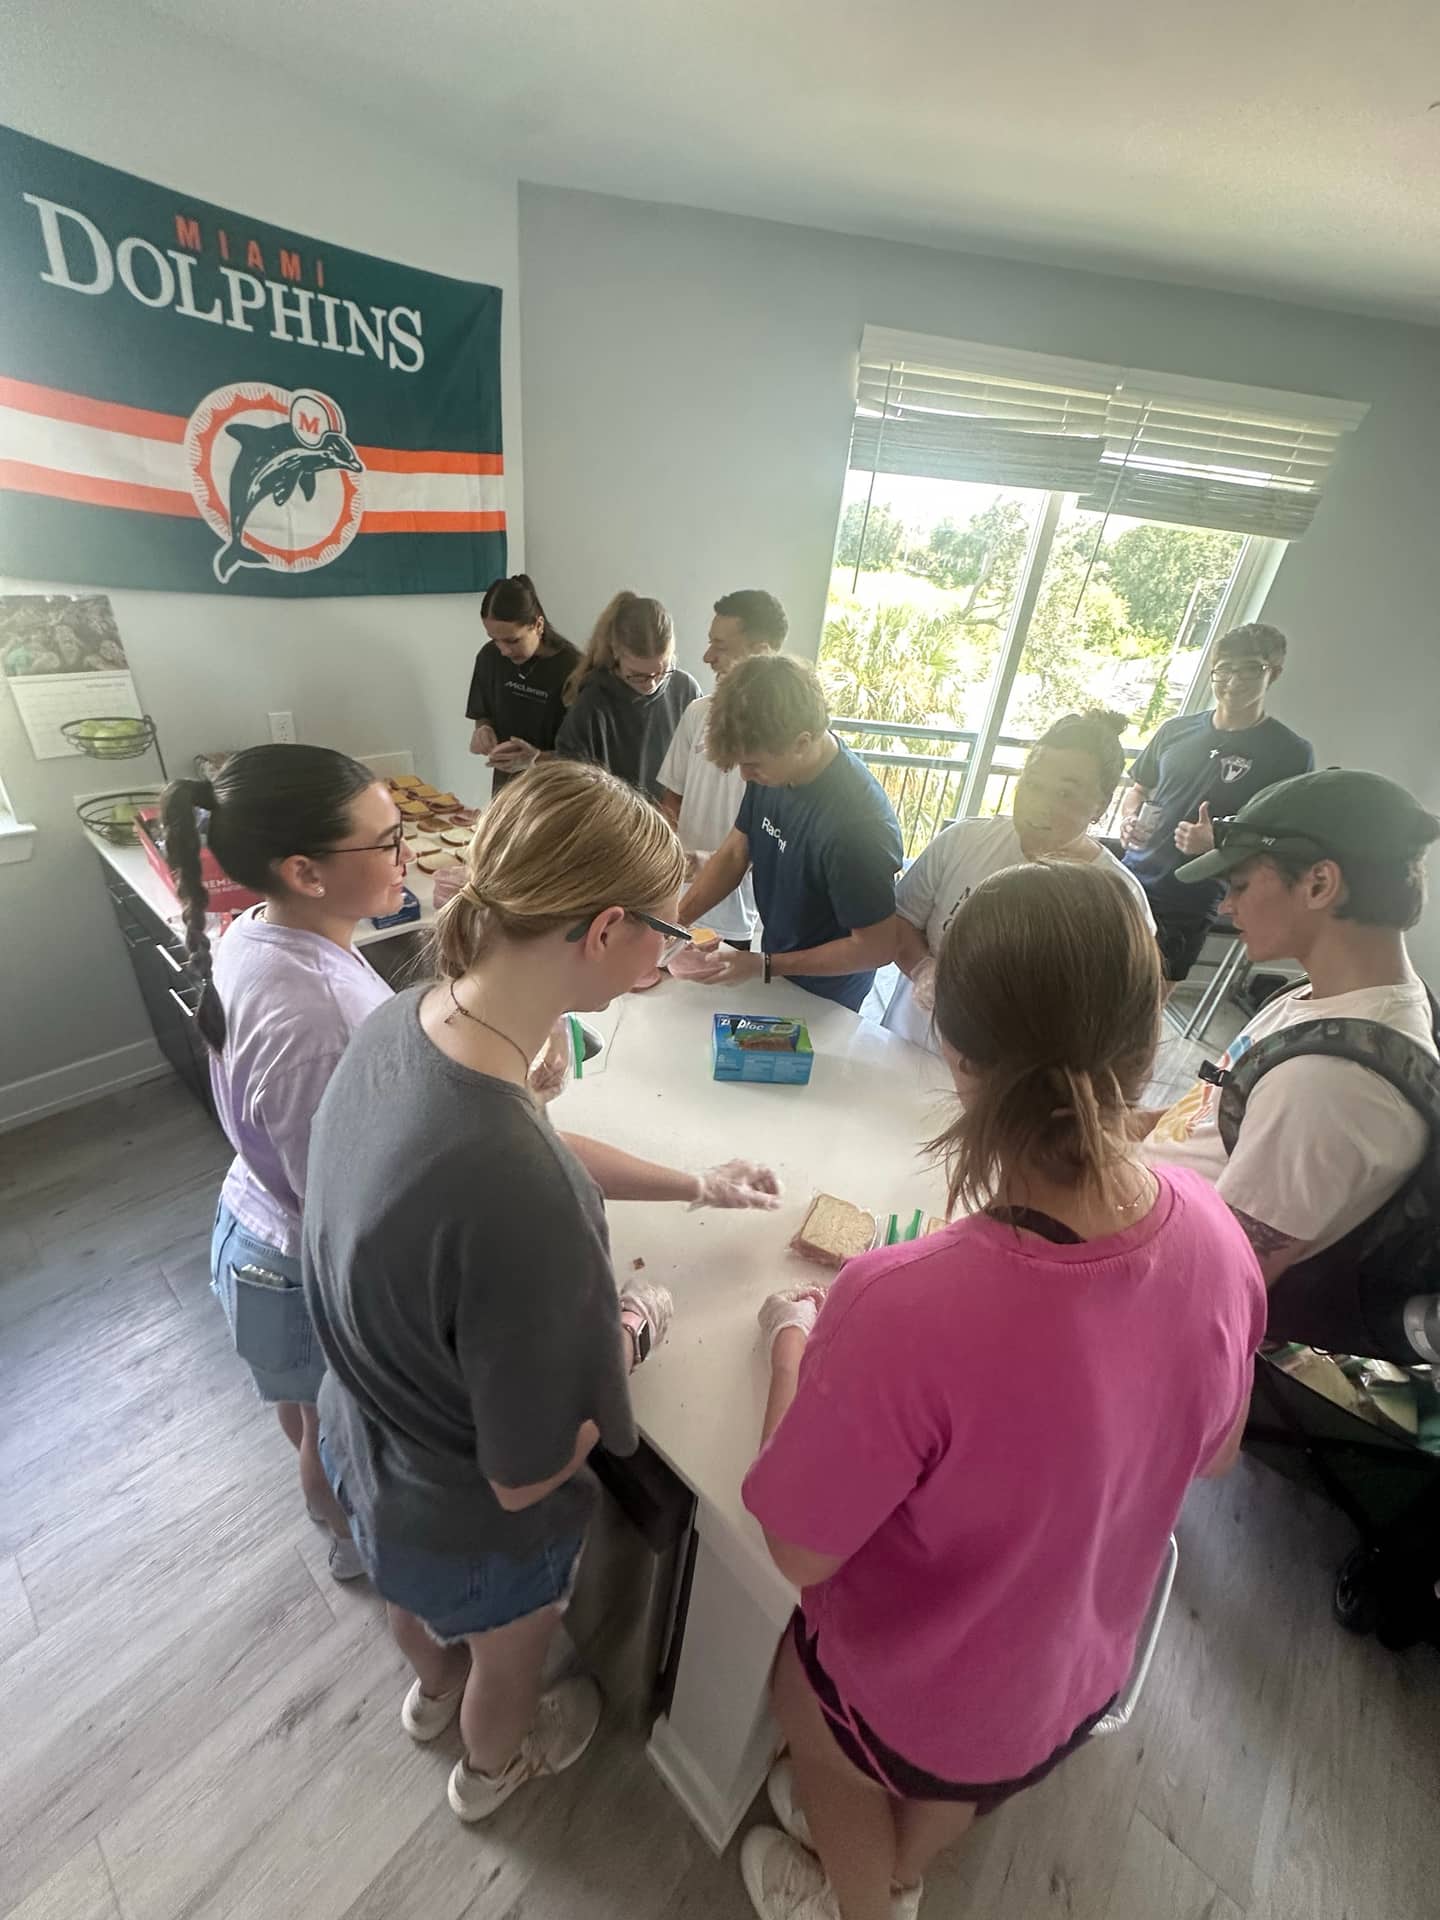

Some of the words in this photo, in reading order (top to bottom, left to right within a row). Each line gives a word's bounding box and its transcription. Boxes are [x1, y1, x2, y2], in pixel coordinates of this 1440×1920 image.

[23, 192, 425, 373] DOLPHINS
[175, 215, 325, 289] MIAMI
[299, 411, 320, 435] M
